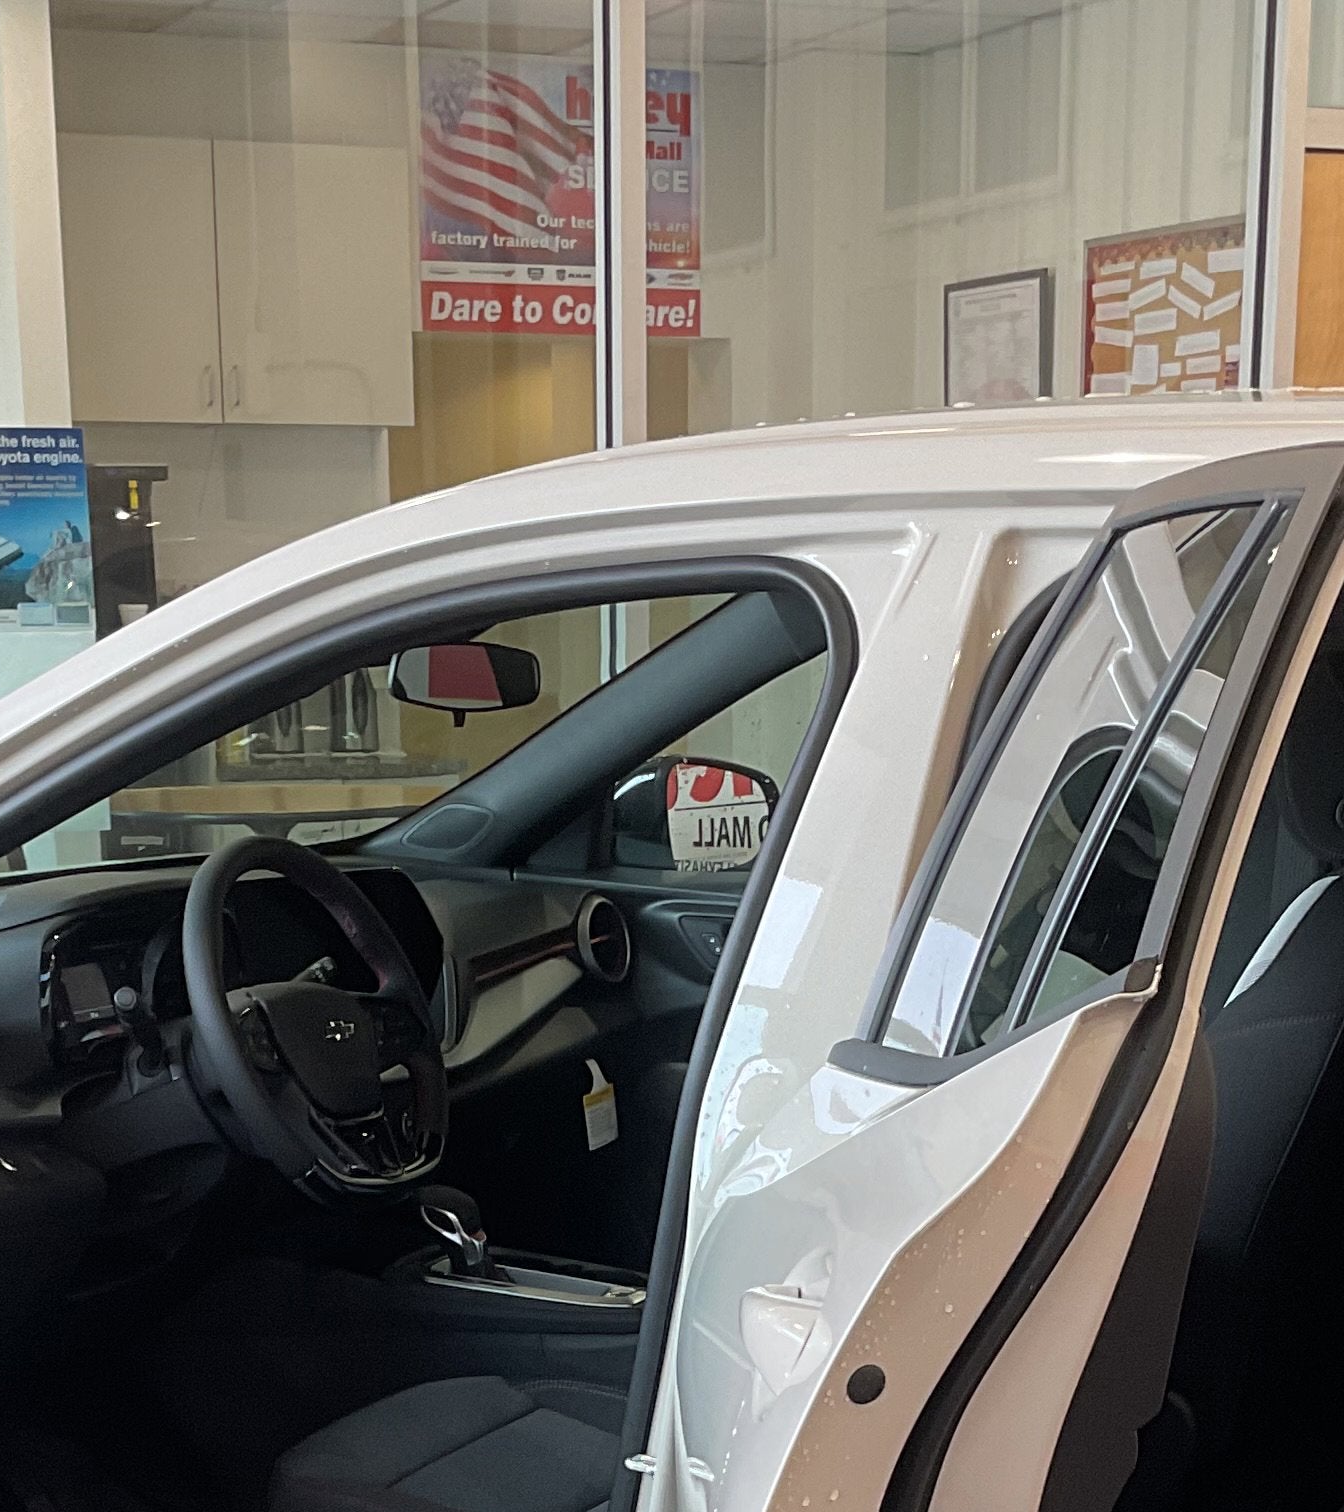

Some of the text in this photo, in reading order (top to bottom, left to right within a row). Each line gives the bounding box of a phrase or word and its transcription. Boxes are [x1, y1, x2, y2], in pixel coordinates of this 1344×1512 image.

[565, 76, 691, 137] hey
[536, 214, 565, 228] Our
[667, 222, 690, 233] are
[431, 231, 690, 254] factory trained for hicle!
[430, 291, 696, 328] Dare to Coare!
[21, 435, 56, 448] fresh
[59, 435, 80, 449] air.
[33, 450, 84, 466] engine.
